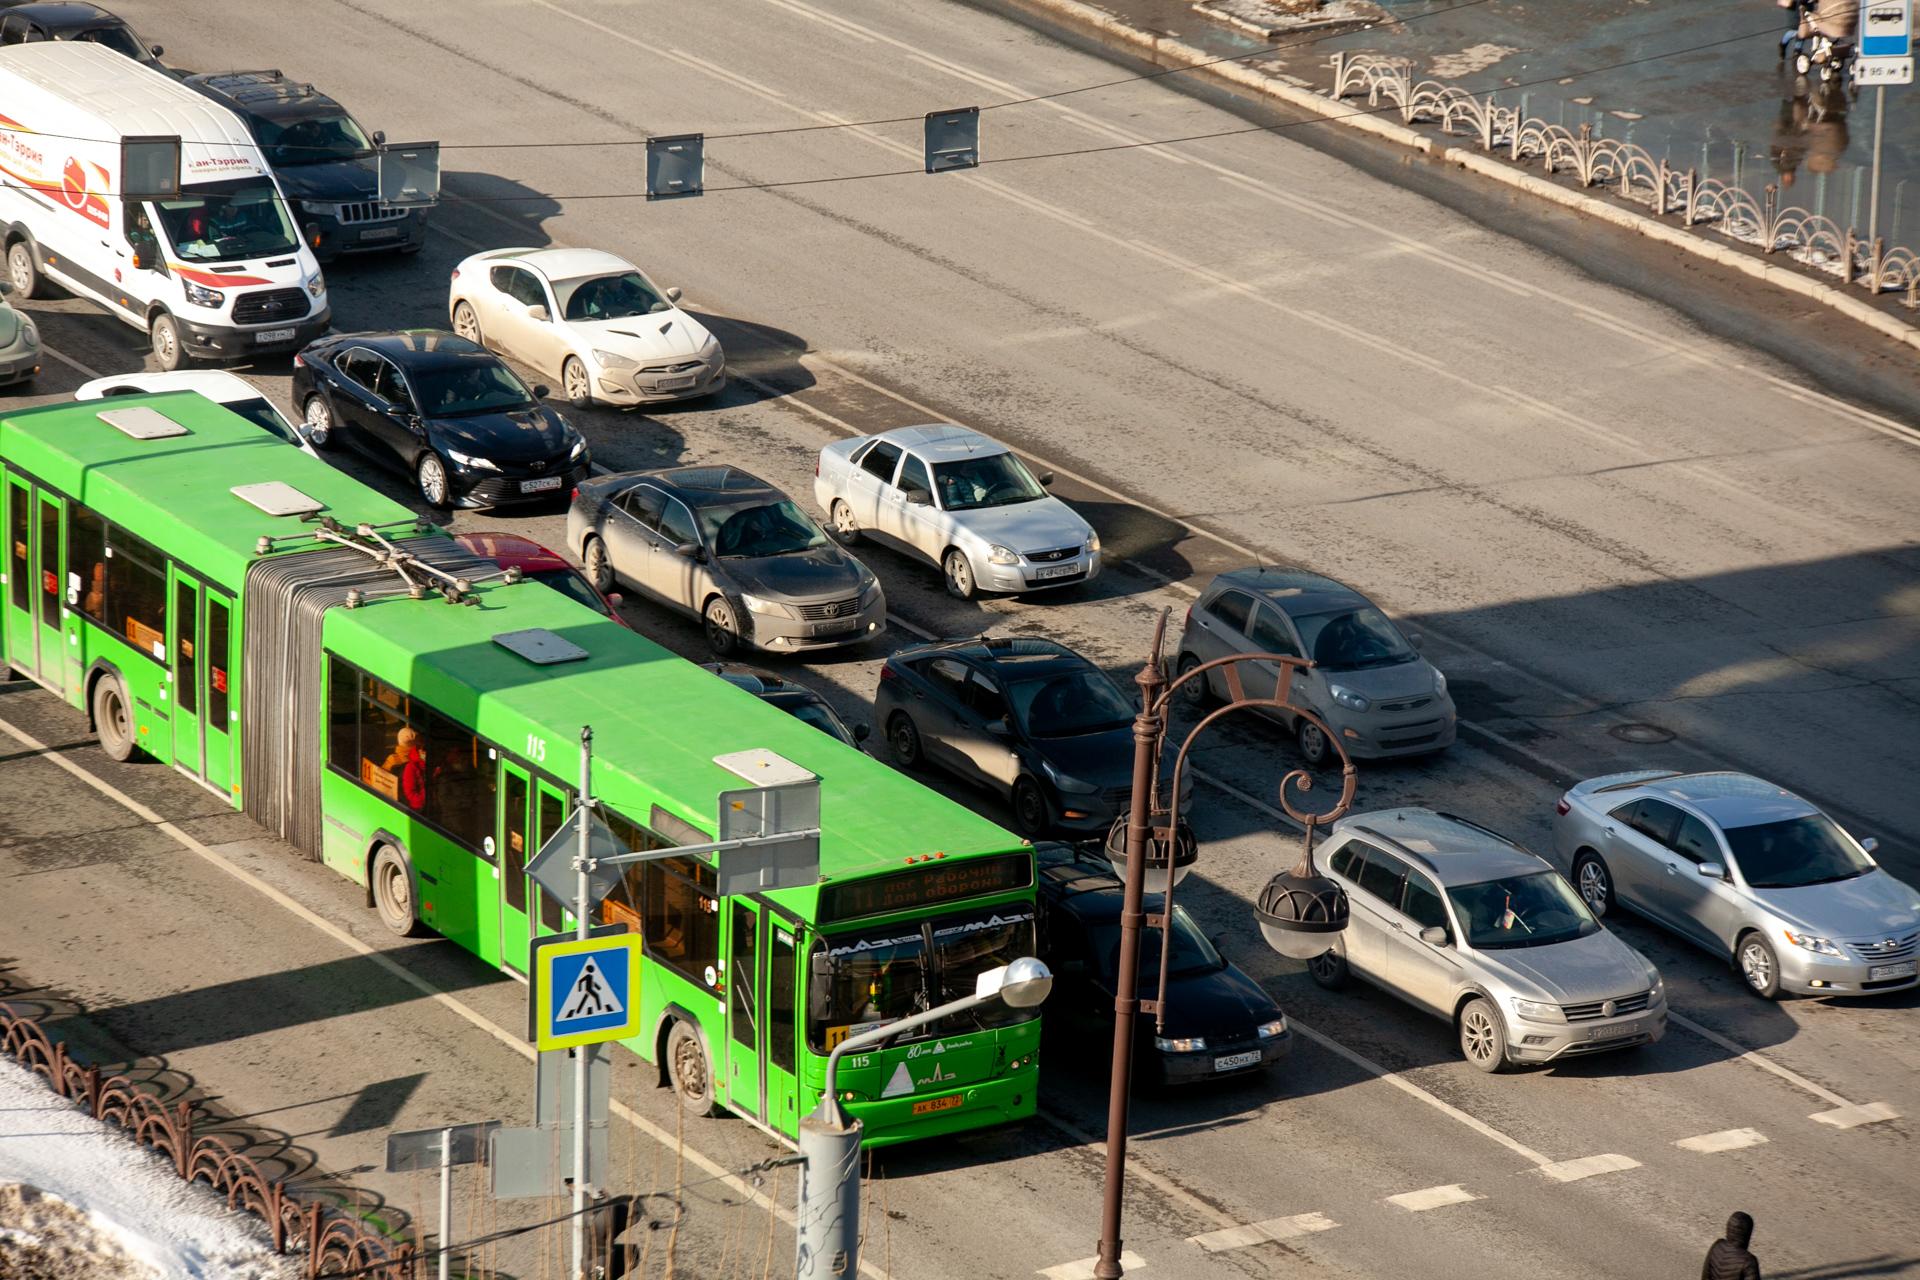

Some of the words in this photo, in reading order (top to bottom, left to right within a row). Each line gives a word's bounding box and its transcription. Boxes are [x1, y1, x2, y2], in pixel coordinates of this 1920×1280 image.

[188, 158, 250, 168] ан-Тэррия
[527, 733, 546, 762] 115
[832, 1031, 846, 1049] 11
[907, 1044, 921, 1059] 80
[852, 1056, 870, 1068] 115
[930, 1099, 947, 1110] 834
